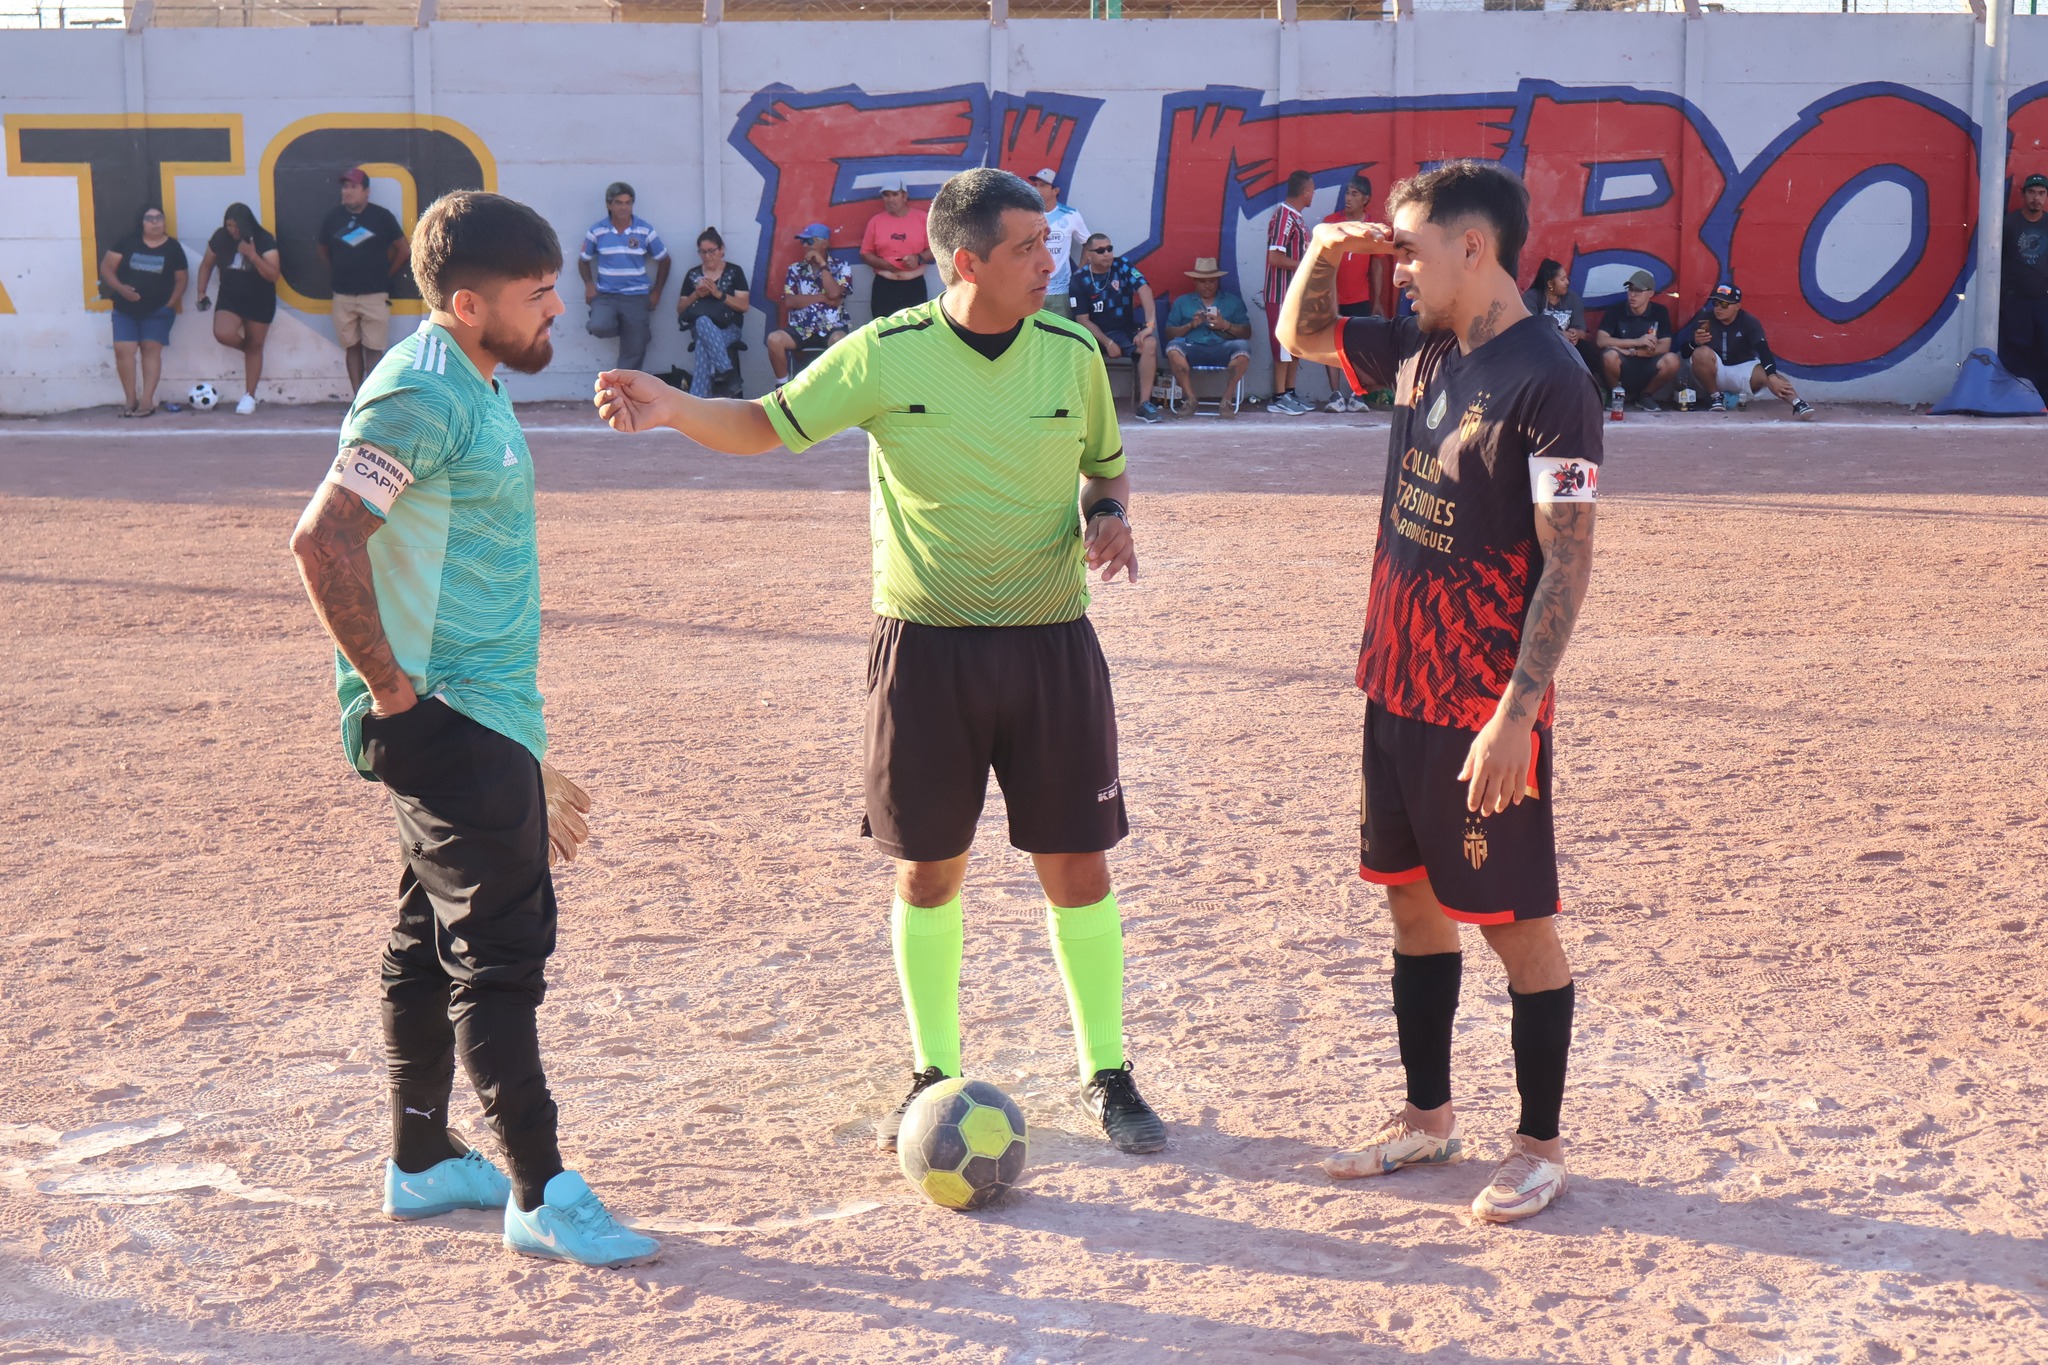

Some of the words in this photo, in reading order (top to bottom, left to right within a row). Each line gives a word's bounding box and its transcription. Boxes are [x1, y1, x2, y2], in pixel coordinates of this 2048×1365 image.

[0, 112, 497, 315] TO
[728, 78, 2048, 381] FUTBO
[1093, 301, 1104, 312] 10
[357, 447, 404, 482] KARINA
[1402, 447, 1443, 484] COLLAO
